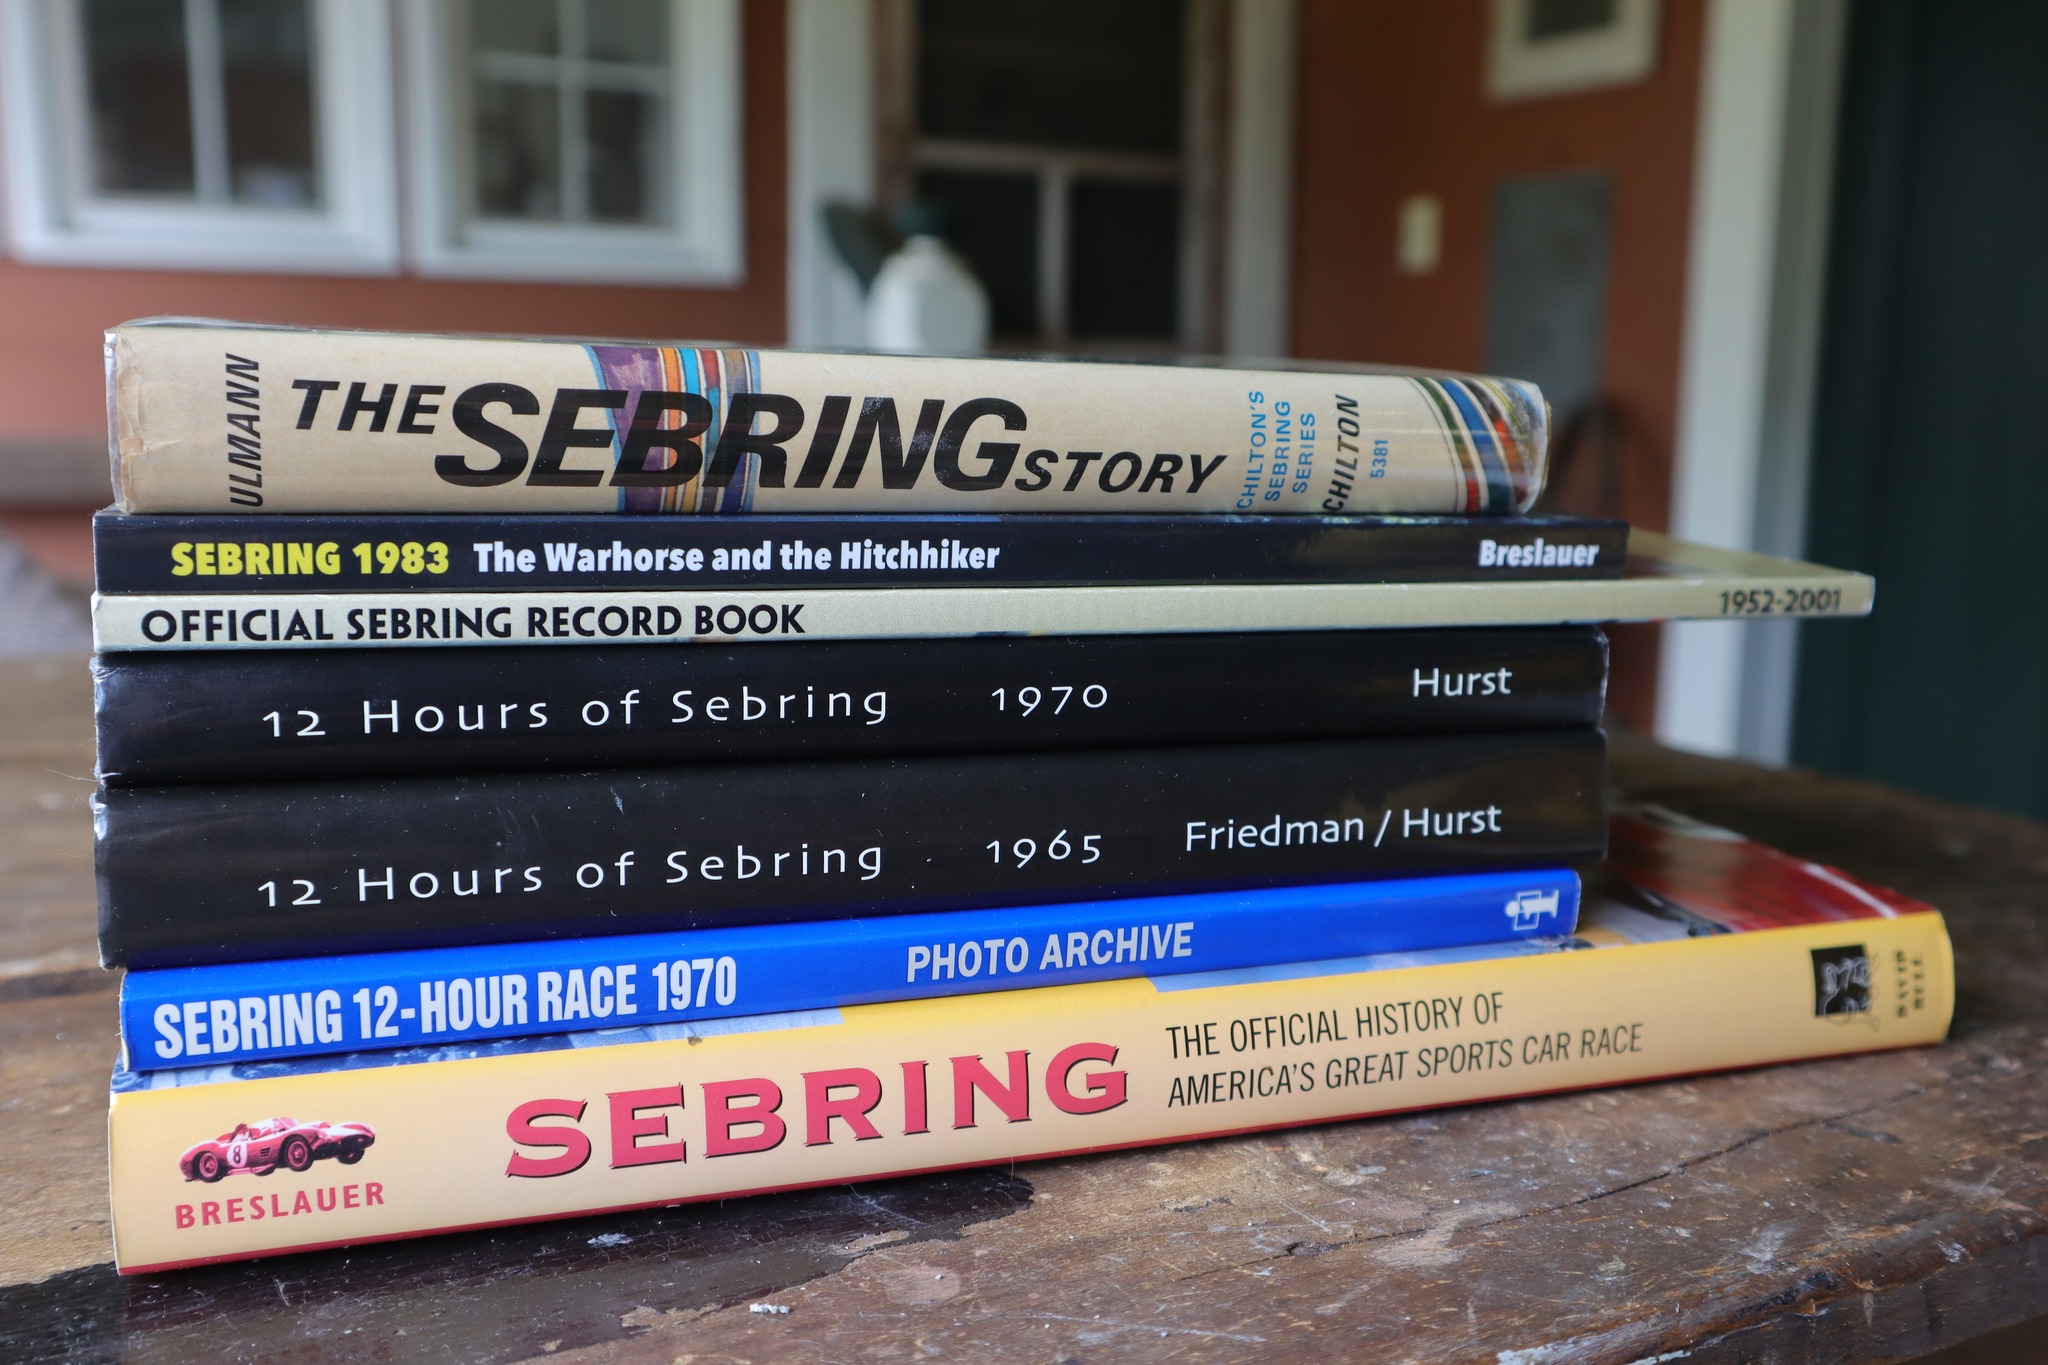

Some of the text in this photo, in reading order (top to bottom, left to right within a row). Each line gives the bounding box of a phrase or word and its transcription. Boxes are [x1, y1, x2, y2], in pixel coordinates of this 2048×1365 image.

[225, 353, 263, 507] ULMANN
[291, 379, 1228, 493] THE SEBRING STORY
[1236, 391, 1266, 509] CHILTON'S
[1264, 401, 1291, 502] SEBRING
[1292, 412, 1315, 493] SERIES
[1322, 393, 1360, 512] CHILTON
[1370, 439, 1388, 478] 5381
[171, 538, 1000, 577] SEBRING 1983 The Warhorse and the Hitchhiker
[1478, 538, 1599, 567] Breslauer
[141, 604, 805, 642] OFFICIAL SEBRING RECORD BOOK
[1719, 588, 1842, 616] 1952-2001
[262, 684, 1108, 738] 12 Hours of Sebring 1970
[1413, 667, 1512, 697] Hurst
[1186, 805, 1501, 851] Friedman / Hurst
[257, 829, 1102, 907] 12 Hours of Sebring 1965
[906, 922, 1194, 982] PHOTO ARCHIVE
[154, 956, 736, 1059] SEBRING 12-HOUR RACE 1970
[1165, 992, 1504, 1059] THE OFFICIAL HISTORY OF
[1167, 1023, 1643, 1108] AMERICA'S GREAT SPORTS CAR RACE
[505, 1042, 1128, 1178] SEBRING
[231, 1144, 243, 1164] 8
[175, 1181, 384, 1229] BRESLAUER
